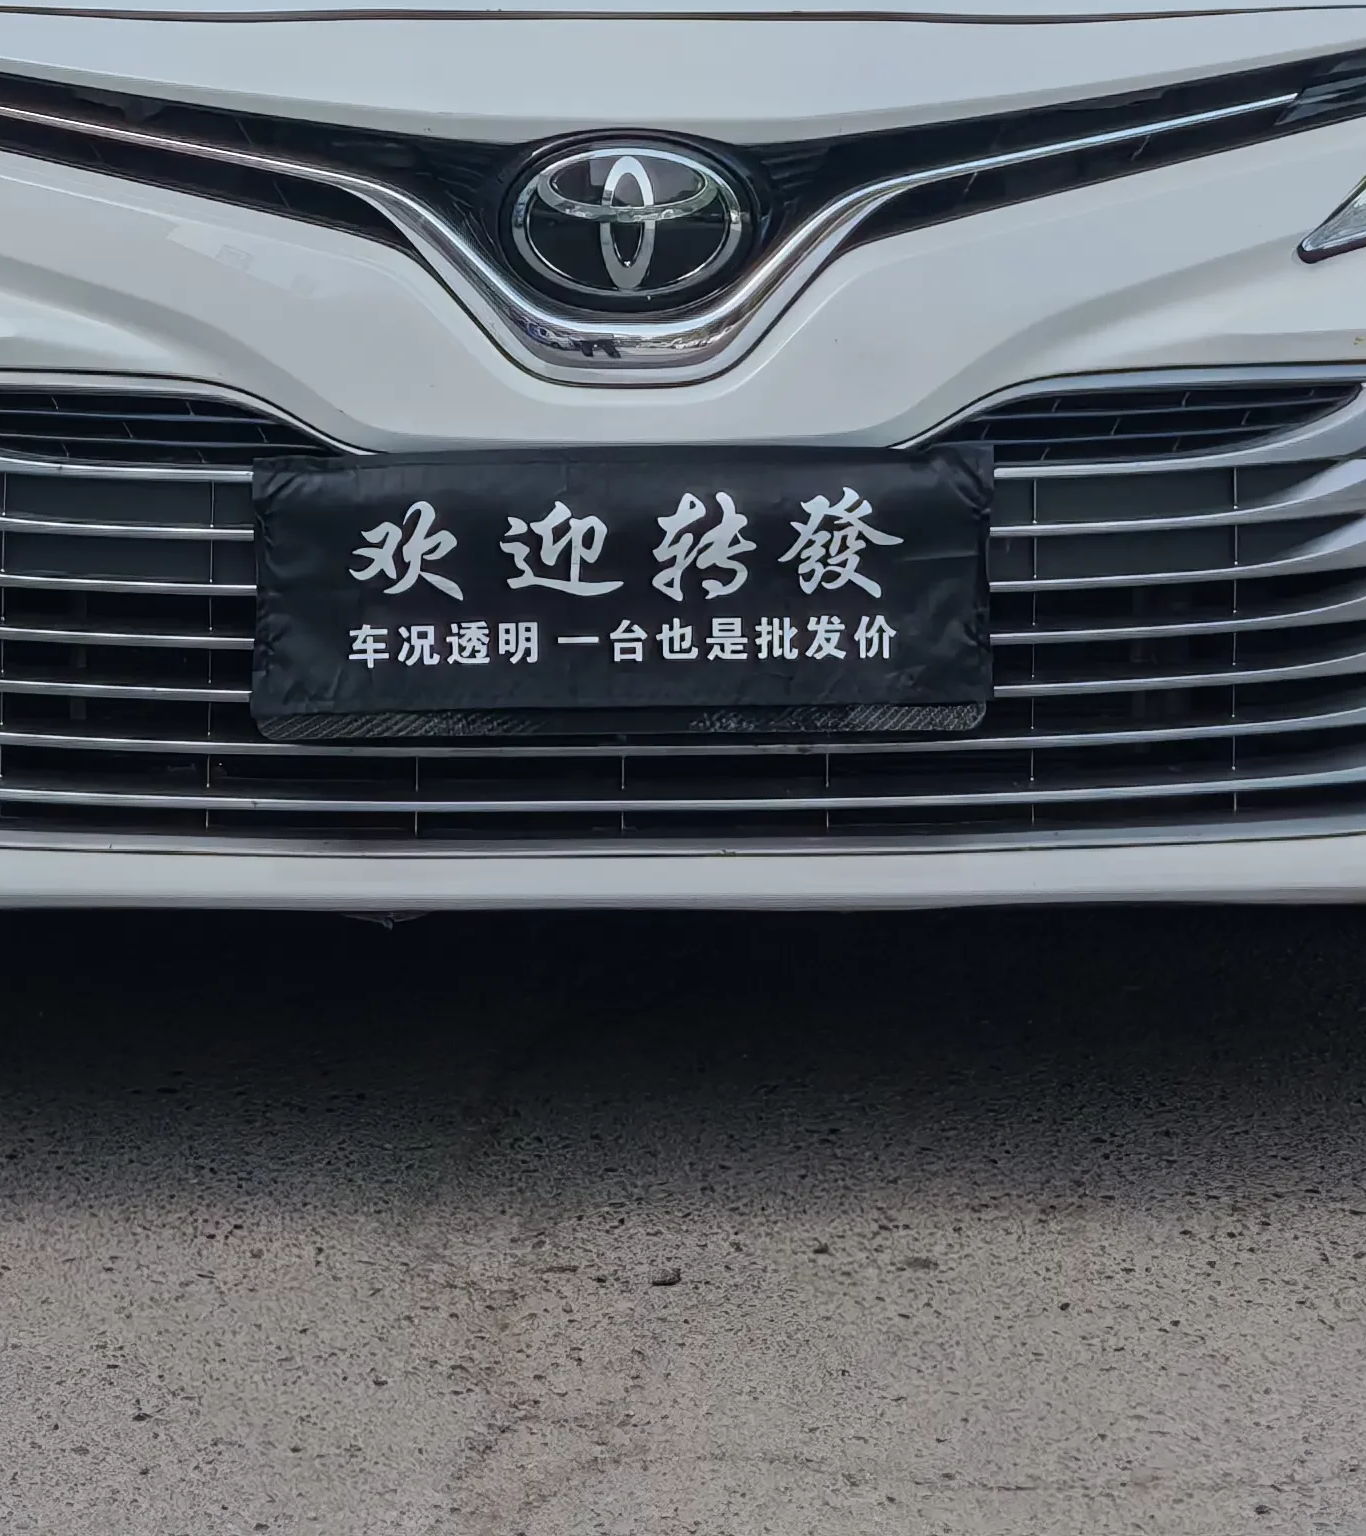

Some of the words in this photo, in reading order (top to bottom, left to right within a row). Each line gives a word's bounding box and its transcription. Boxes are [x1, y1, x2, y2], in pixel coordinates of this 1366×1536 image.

[348, 486, 904, 602] 欢迎转發
[348, 619, 539, 669] 车况透明
[557, 614, 898, 663] 一台也是批发价
